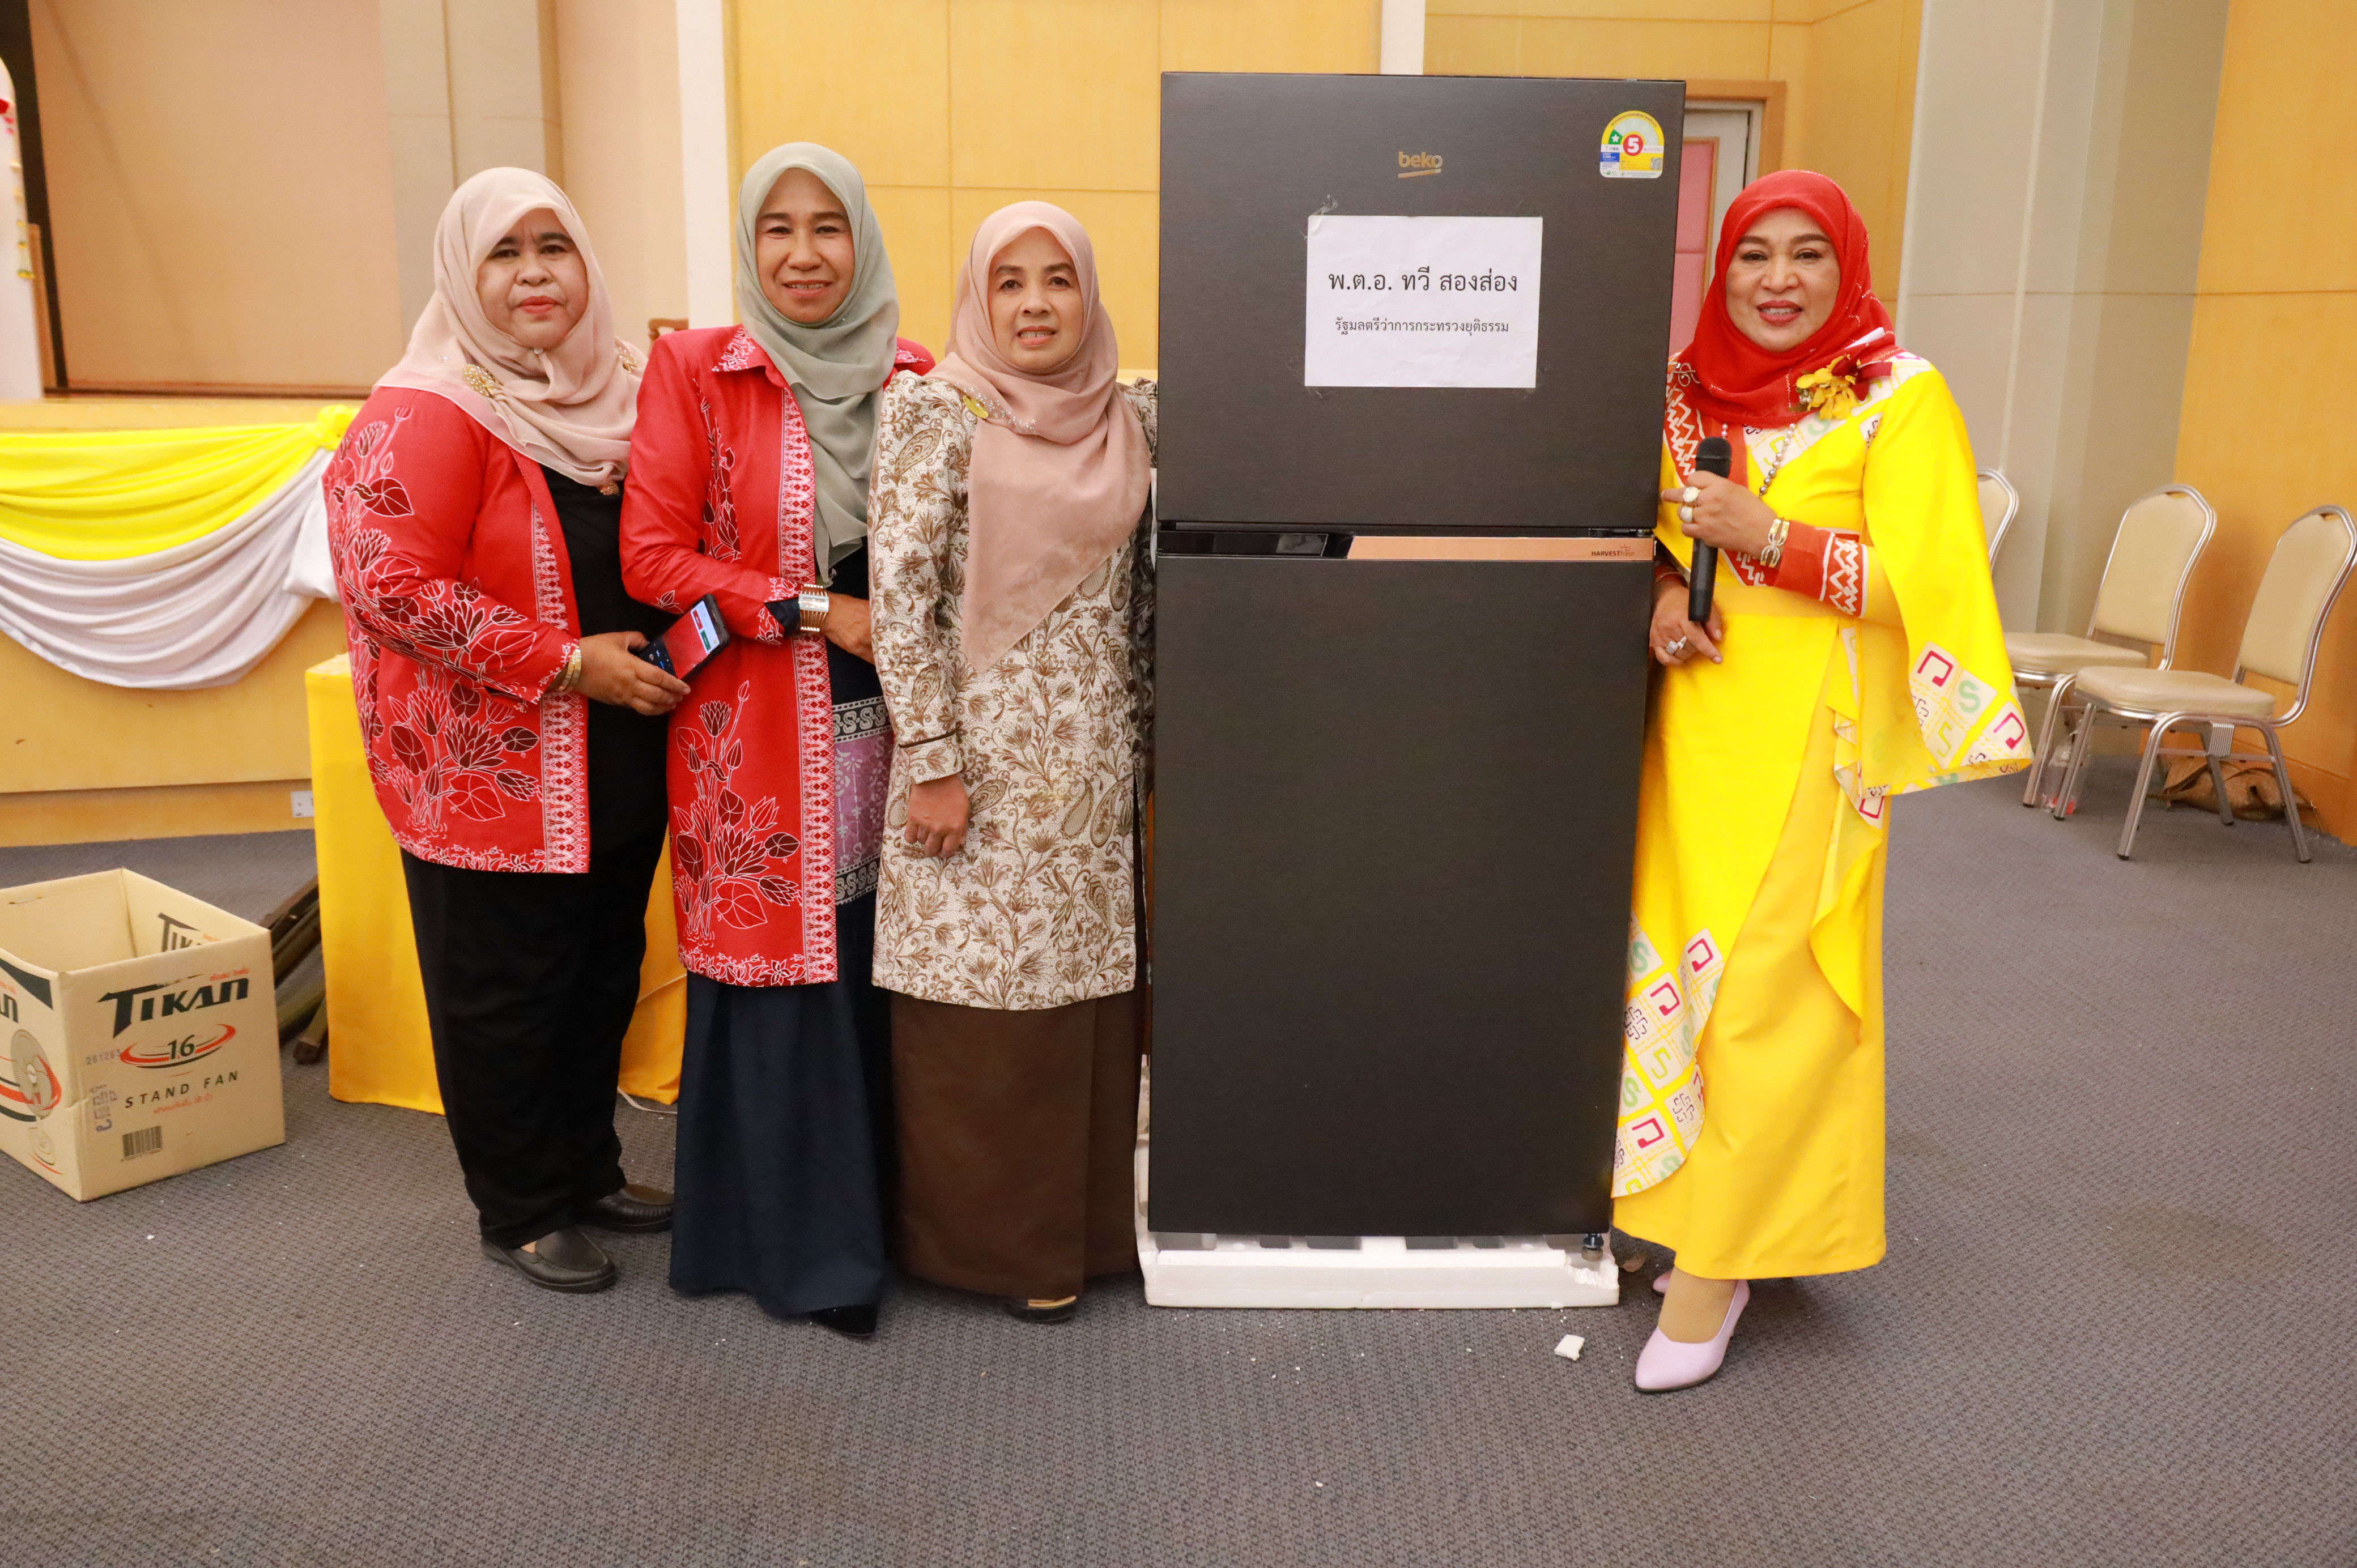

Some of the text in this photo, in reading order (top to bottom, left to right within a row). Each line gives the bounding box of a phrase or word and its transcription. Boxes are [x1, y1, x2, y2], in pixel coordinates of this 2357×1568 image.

[1627, 137, 1640, 154] 5
[1398, 151, 1443, 168] beko
[1328, 266, 1517, 291] พ.ต.อ. ทวี สองส่อง
[168, 1034, 195, 1060] 16
[125, 1083, 190, 1109] STAND
[203, 1071, 239, 1089] FAN
